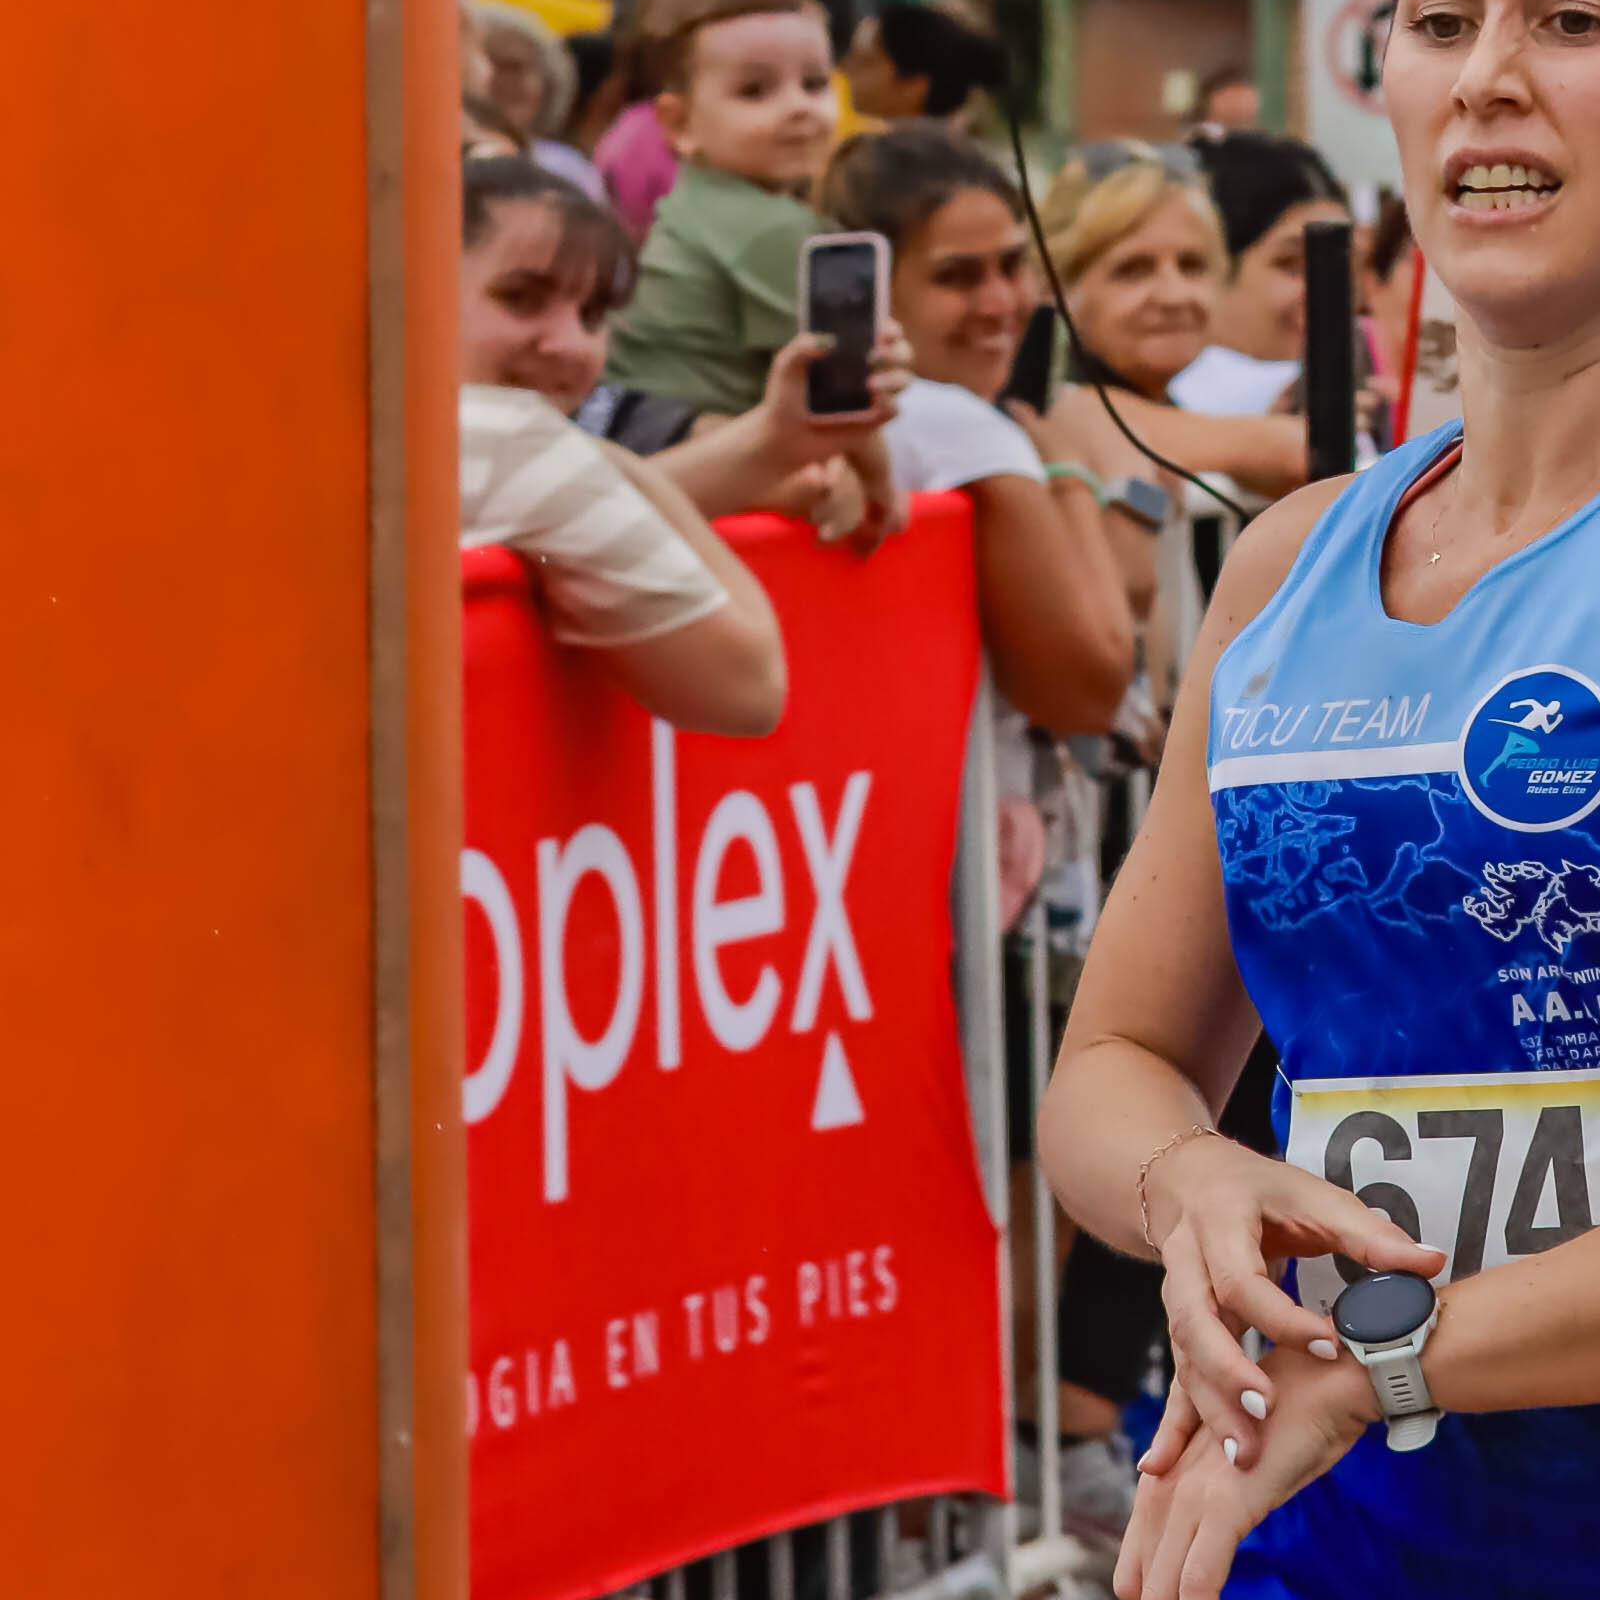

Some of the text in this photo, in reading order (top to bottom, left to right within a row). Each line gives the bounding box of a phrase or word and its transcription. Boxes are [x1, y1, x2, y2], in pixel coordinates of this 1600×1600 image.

[1220, 691, 1433, 750] TUCU TEAM
[1506, 757, 1600, 770] PEDRO LUIS
[1527, 770, 1597, 784] GOMEZ
[1561, 785, 1587, 795] Elite
[460, 715, 875, 1204] oplex
[1497, 967, 1532, 983] SON
[604, 1307, 662, 1390] EN
[680, 1273, 773, 1361] TUS
[796, 1243, 901, 1328] PIES
